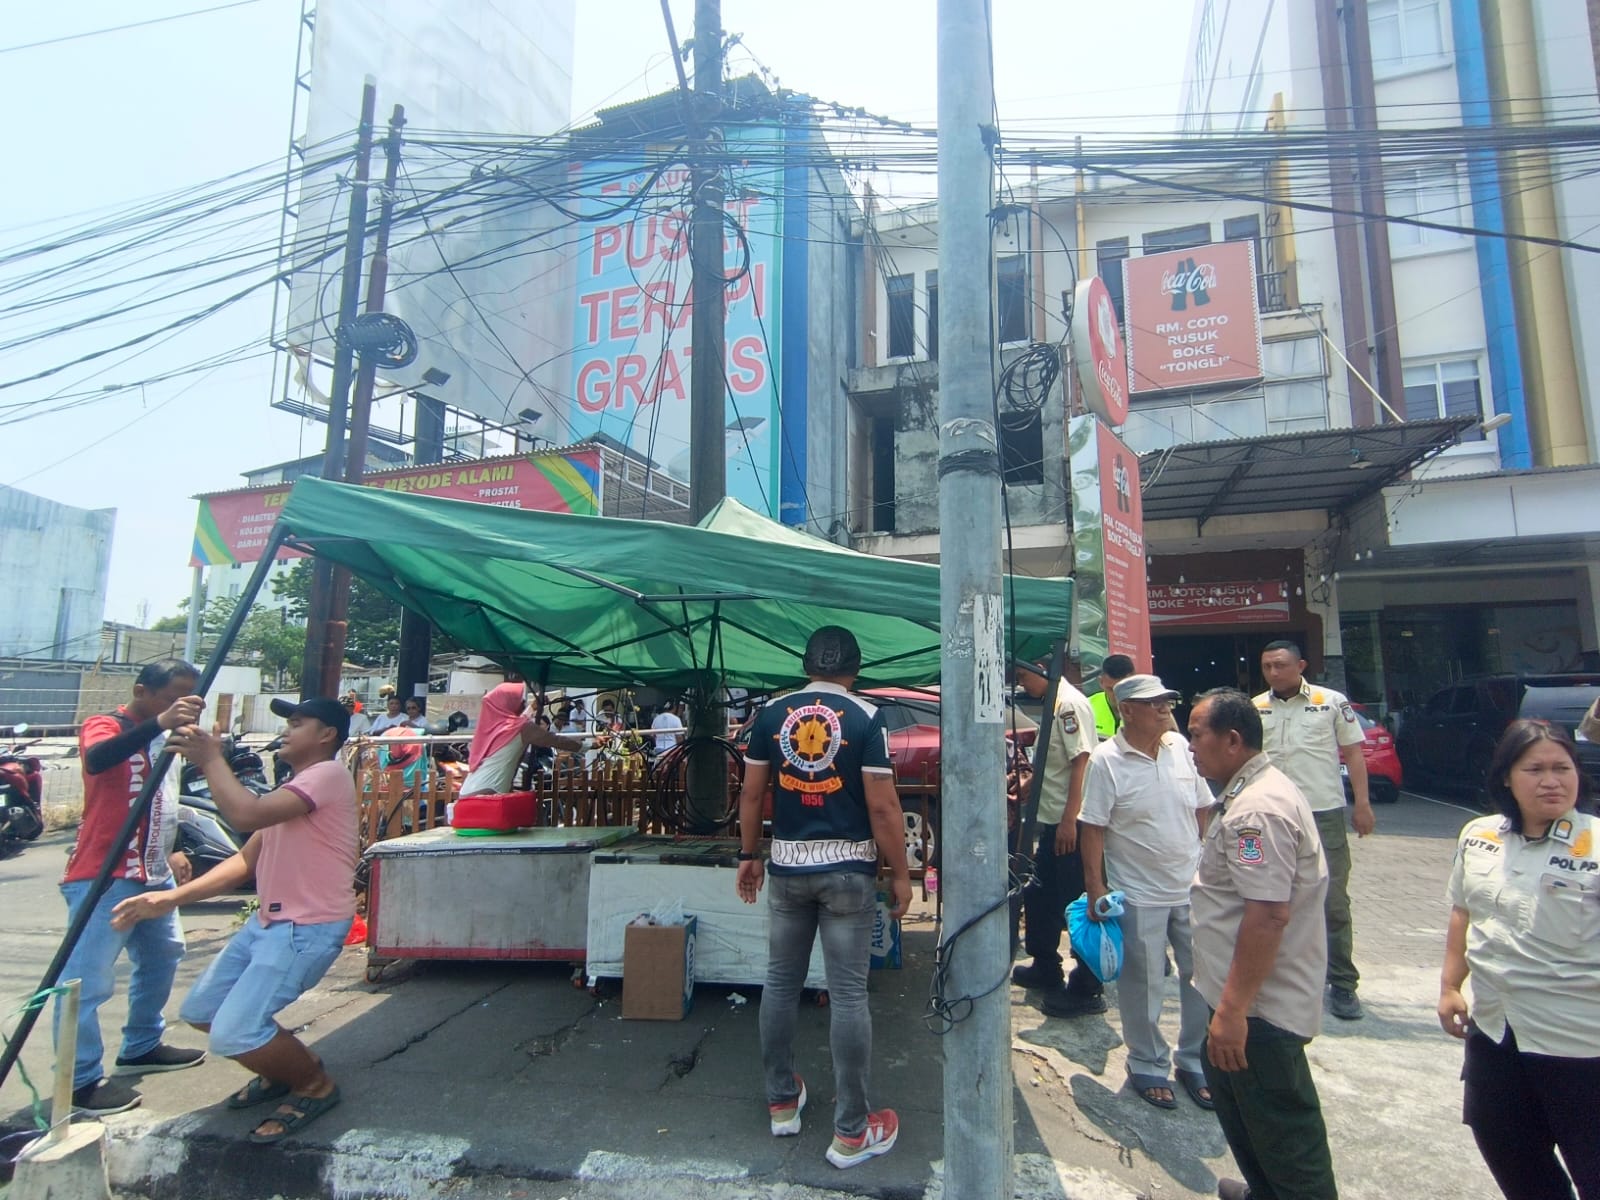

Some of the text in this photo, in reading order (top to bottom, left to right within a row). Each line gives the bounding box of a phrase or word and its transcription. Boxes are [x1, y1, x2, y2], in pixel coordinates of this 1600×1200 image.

[591, 197, 759, 276] PUST
[1155, 315, 1229, 334] RM. COTO
[1167, 329, 1219, 346] RUSUK
[1172, 343, 1216, 359] BOKE
[576, 336, 766, 413] GRAS
[456, 465, 515, 486] ALAMI
[1208, 585, 1256, 597] RUSUK
[1149, 599, 1185, 609] BOKE
[1304, 705, 1319, 713] POL
[1549, 856, 1577, 872] POL
